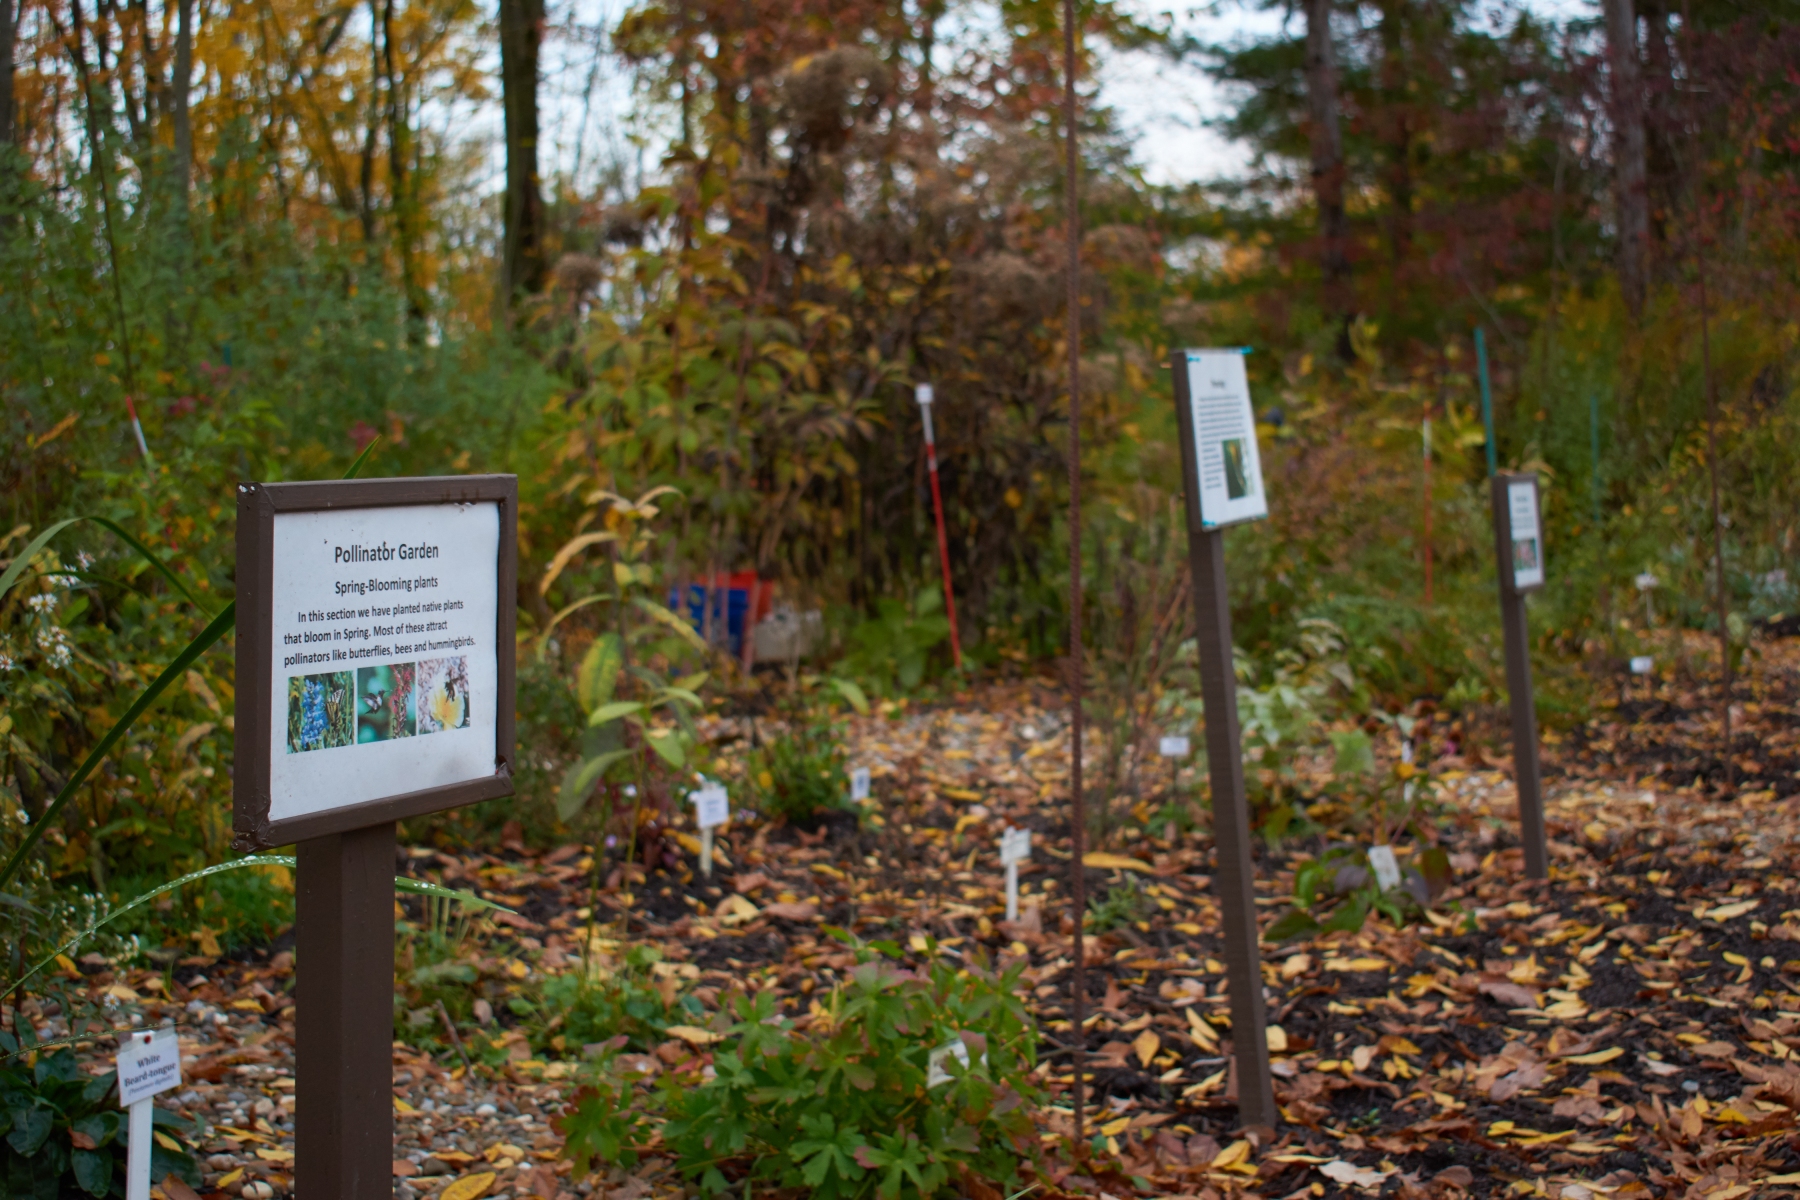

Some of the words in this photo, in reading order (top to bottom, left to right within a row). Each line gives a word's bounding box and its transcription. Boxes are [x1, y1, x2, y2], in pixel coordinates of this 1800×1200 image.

[334, 544, 395, 563] Pollinator
[399, 542, 439, 560] Garden
[335, 578, 412, 596] Spring-Blooming
[414, 576, 438, 591] plants
[298, 612, 306, 622] In
[308, 610, 324, 622] this
[326, 607, 356, 620] section
[358, 607, 370, 617] we
[372, 606, 391, 616] have
[393, 602, 420, 617] planted
[422, 601, 442, 612] native
[444, 600, 463, 610] plants
[284, 632, 302, 644] that
[304, 630, 331, 643] bloom
[334, 630, 341, 640] in
[343, 626, 371, 641] Spring.
[373, 626, 394, 636] Most
[396, 623, 404, 635] of
[405, 622, 424, 633] these
[426, 620, 447, 631] attract
[284, 652, 330, 668] pollinators
[332, 649, 347, 660] like
[349, 645, 393, 659] butterflies,
[395, 643, 412, 654] bees
[414, 641, 426, 652] and
[428, 636, 476, 651] hummingbirds.
[137, 1054, 160, 1068] White
[124, 1062, 176, 1087] Beard-tongue
